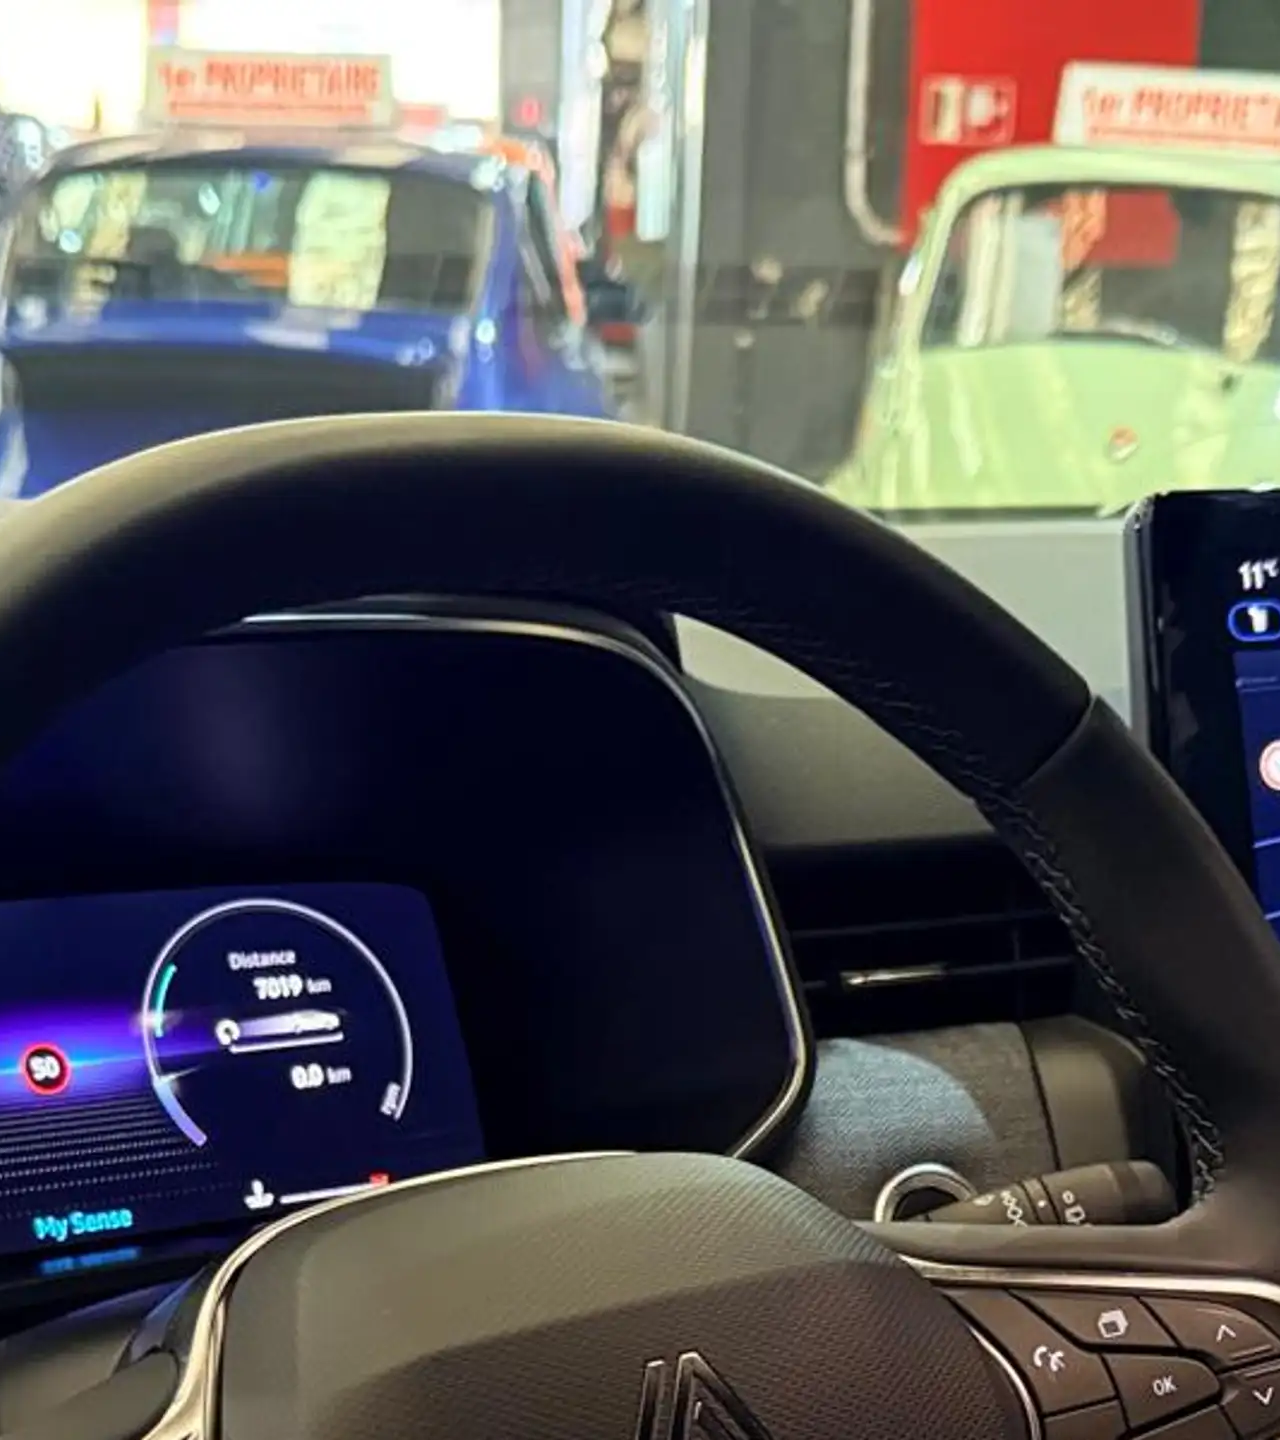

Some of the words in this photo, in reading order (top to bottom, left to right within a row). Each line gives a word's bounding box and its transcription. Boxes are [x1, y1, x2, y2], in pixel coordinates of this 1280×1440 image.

[227, 949, 297, 971] Distance
[252, 973, 304, 1000] 7019
[305, 977, 332, 995] km
[29, 1054, 61, 1081] 50
[326, 1066, 352, 1085] km
[33, 1215, 68, 1242] My
[70, 1208, 133, 1235] Sense
[1152, 1375, 1178, 1396] OK
